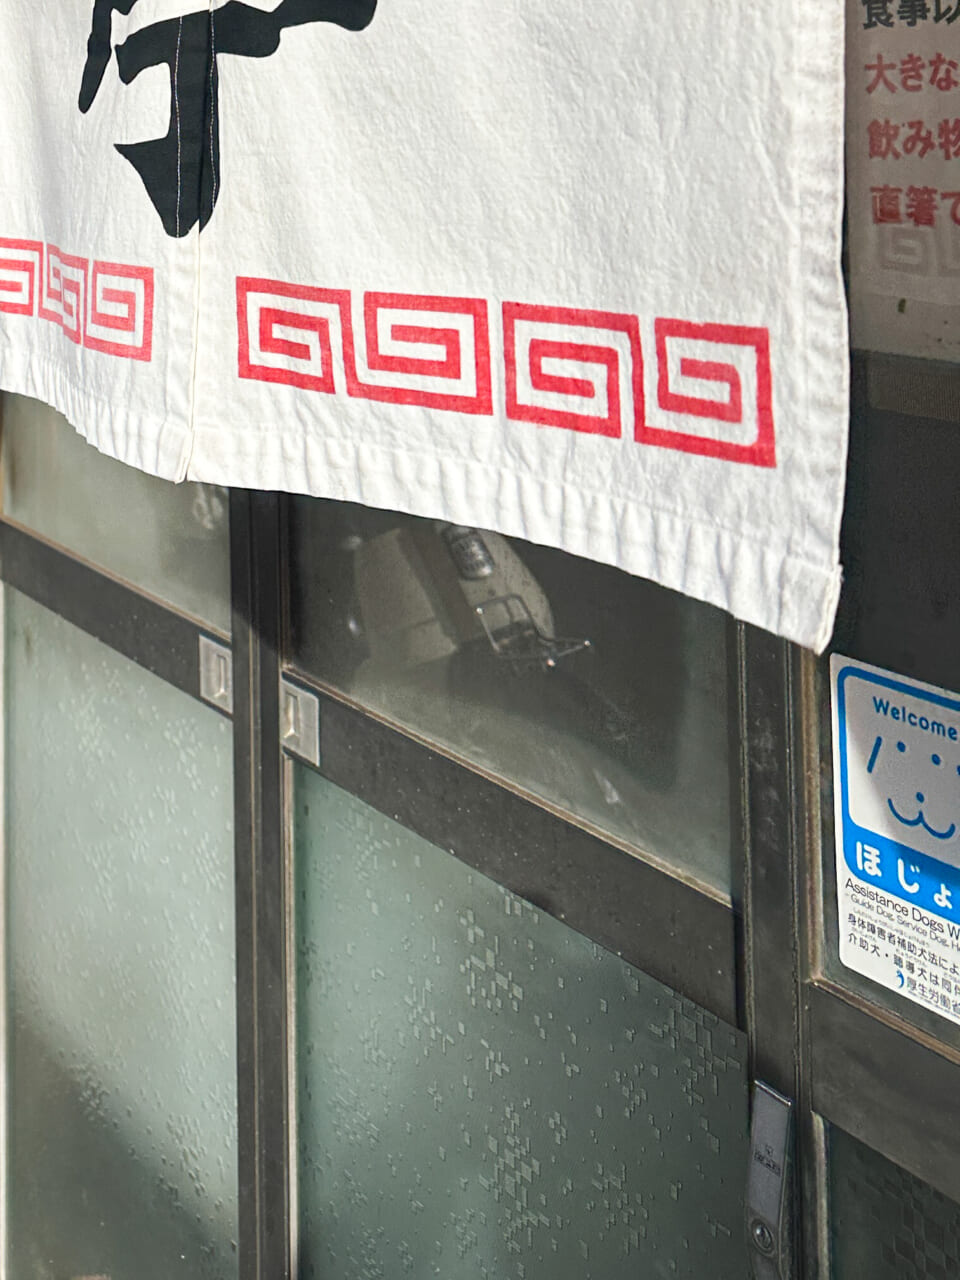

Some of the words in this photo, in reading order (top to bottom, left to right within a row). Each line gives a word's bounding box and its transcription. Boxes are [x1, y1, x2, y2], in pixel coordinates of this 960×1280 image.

[864, 52, 960, 94] 大きな
[873, 696, 958, 741] Welcome
[856, 841, 953, 909] ほじょ
[845, 878, 908, 916] Assistance
[912, 907, 944, 933] Dogs
[897, 915, 927, 936] Service
